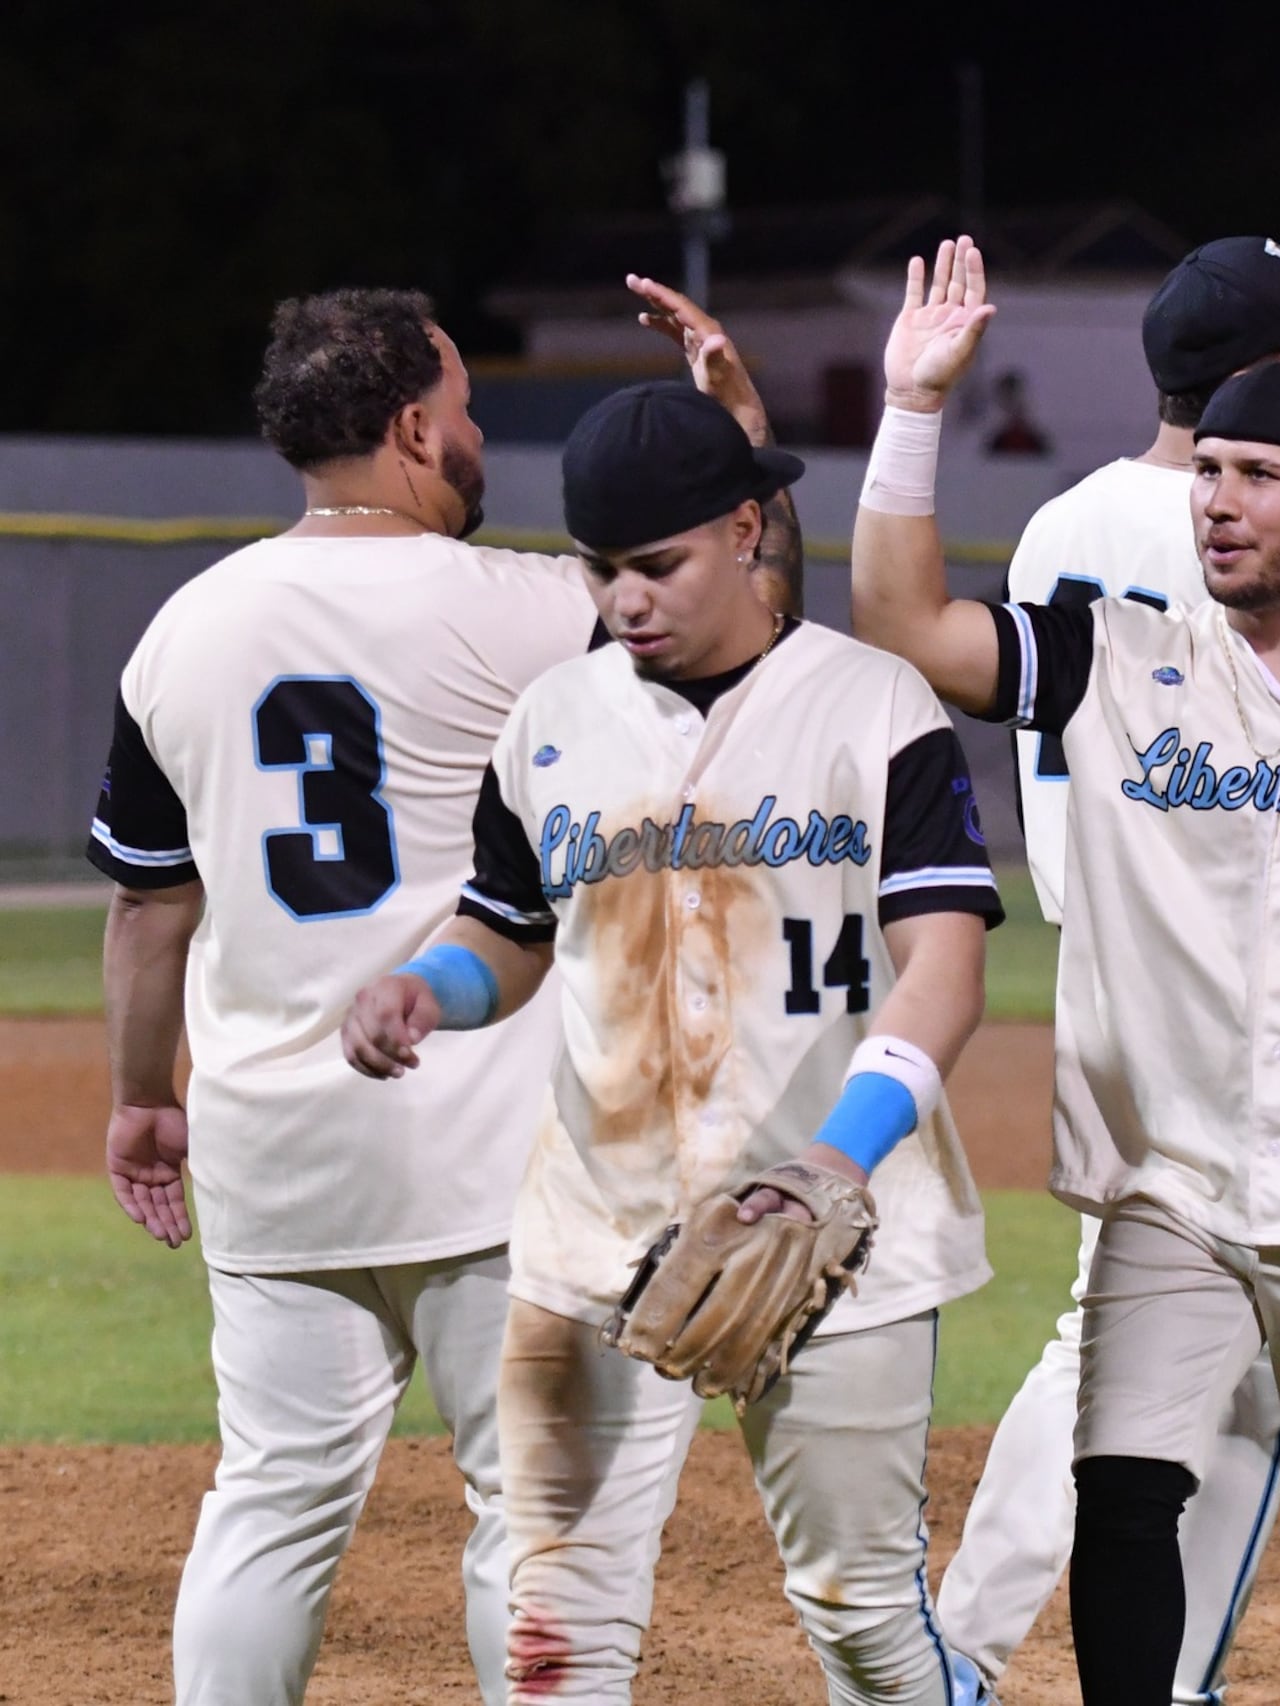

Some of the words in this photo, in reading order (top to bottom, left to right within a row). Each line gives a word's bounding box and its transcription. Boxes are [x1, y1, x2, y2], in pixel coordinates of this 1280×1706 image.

[251, 674, 402, 923] 3
[540, 795, 872, 902] Libertadores
[782, 913, 869, 1014] 14
